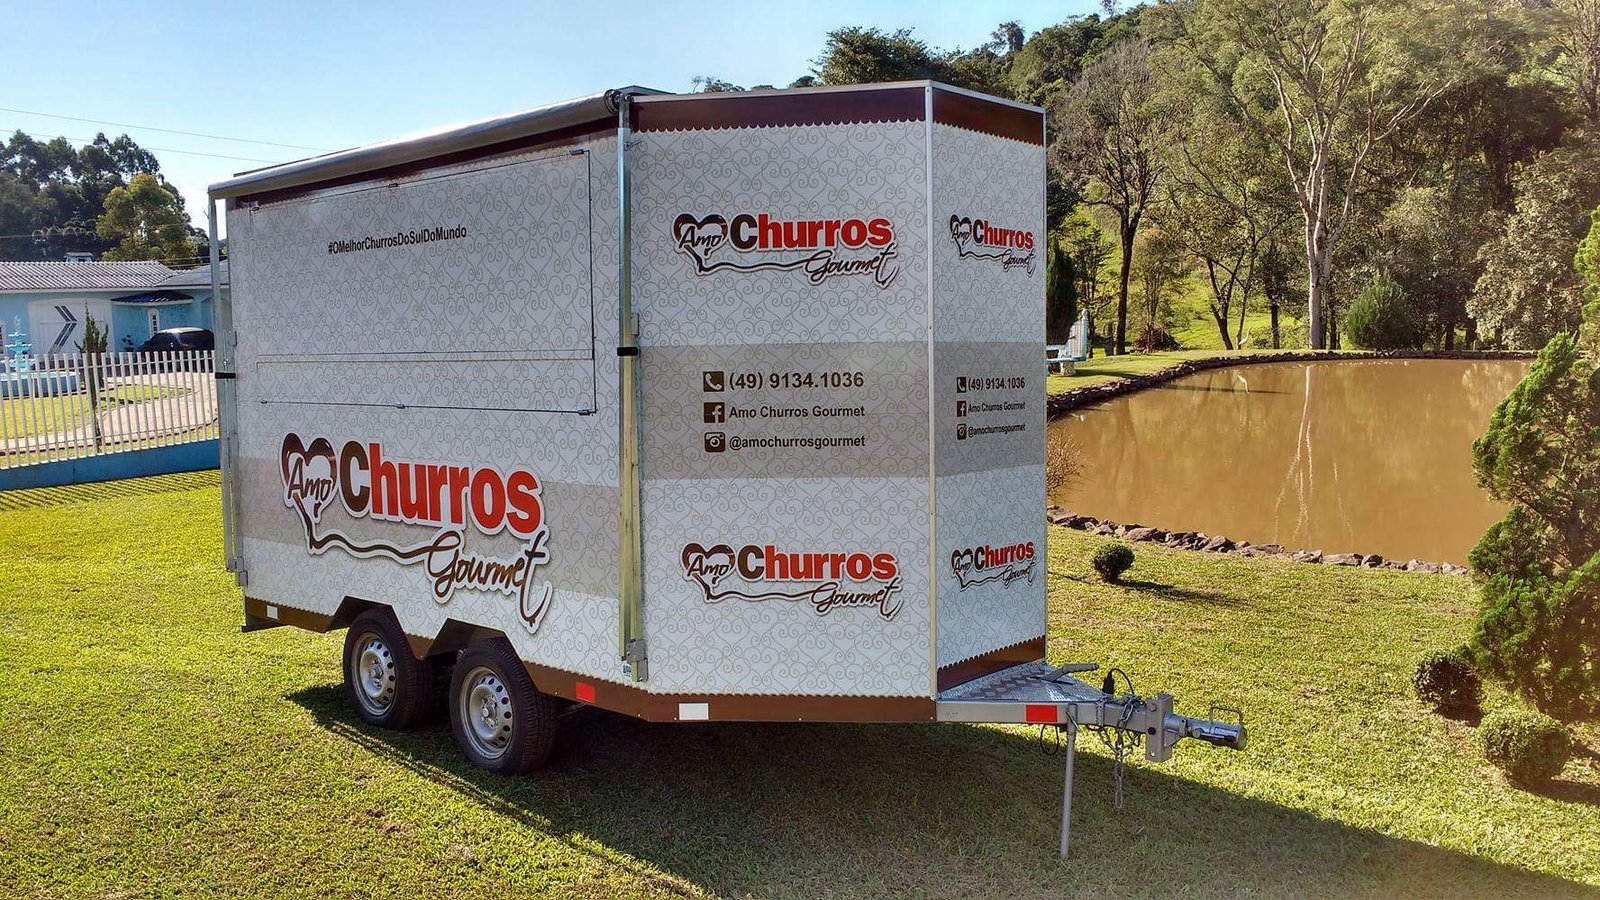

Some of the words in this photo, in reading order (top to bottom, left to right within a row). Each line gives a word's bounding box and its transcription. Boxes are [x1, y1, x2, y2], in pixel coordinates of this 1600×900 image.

[328, 224, 467, 255] #OMelhorChurrosDoSulDoMundo
[679, 226, 722, 249] Amo
[730, 213, 893, 250] Churros
[973, 219, 1034, 250] Churros
[805, 242, 897, 285] Gourmet
[729, 372, 763, 390] (49)
[769, 372, 865, 389] 9134.1036
[968, 377, 983, 391] (49)
[985, 377, 1026, 390] 9134.1036
[729, 407, 757, 419] Amo
[760, 406, 809, 418] Churros
[812, 405, 866, 418] Gourmet
[968, 404, 980, 413] Amo
[981, 402, 1003, 412] Churros
[1003, 401, 1026, 411] Gourmet
[729, 435, 866, 451] @amochurrosgourmet
[968, 423, 1026, 438] @amochurrosgourmet
[287, 456, 333, 500] Amo
[339, 440, 542, 534] Churros
[687, 555, 730, 577] Amo
[737, 544, 897, 580] Churros
[974, 541, 1034, 571] Churros
[427, 530, 551, 625] Gourmet
[811, 577, 901, 619] Gourmet
